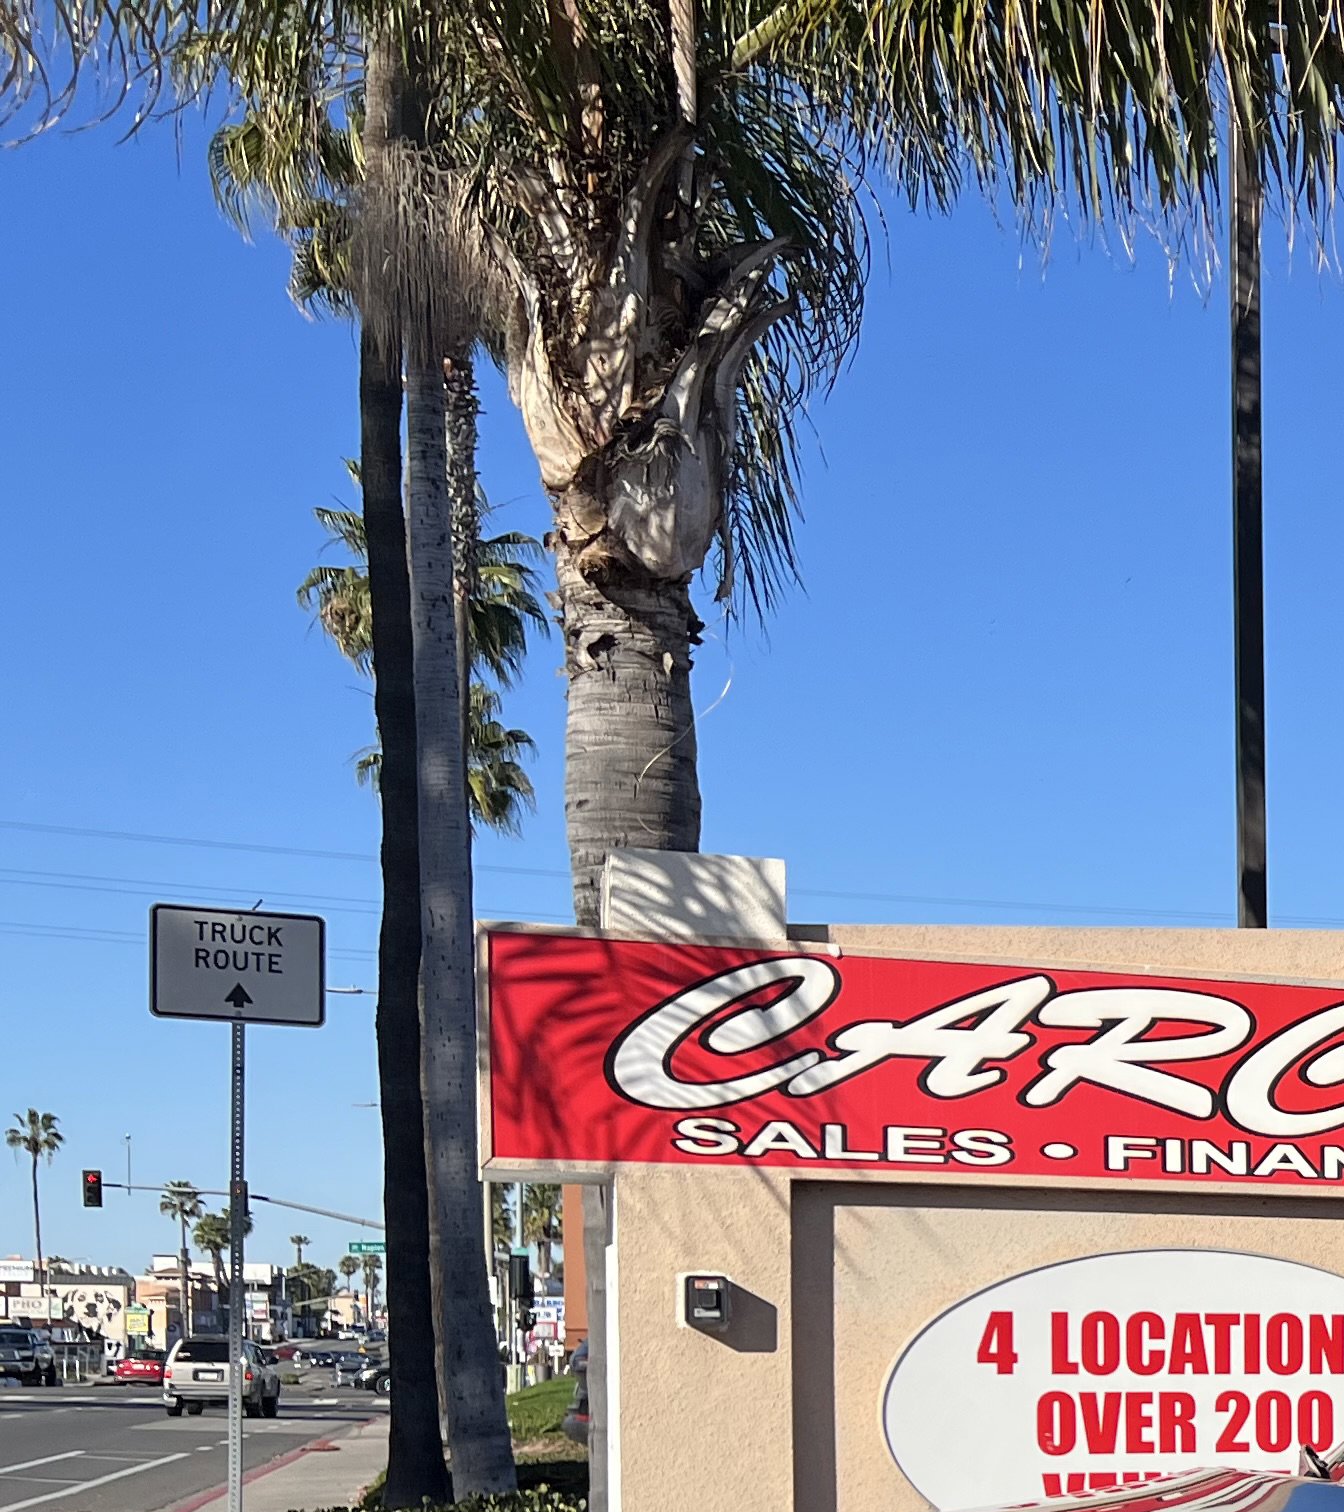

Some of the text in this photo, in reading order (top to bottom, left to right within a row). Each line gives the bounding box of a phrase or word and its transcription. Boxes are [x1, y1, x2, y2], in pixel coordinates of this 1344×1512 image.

[194, 920, 283, 946] TRUCK
[194, 948, 283, 973] ROUTE
[672, 1117, 1014, 1165] SALES
[13, 1299, 42, 1309] PHO
[977, 1311, 1018, 1375] 4
[1036, 1391, 1333, 1455] OVER 200
